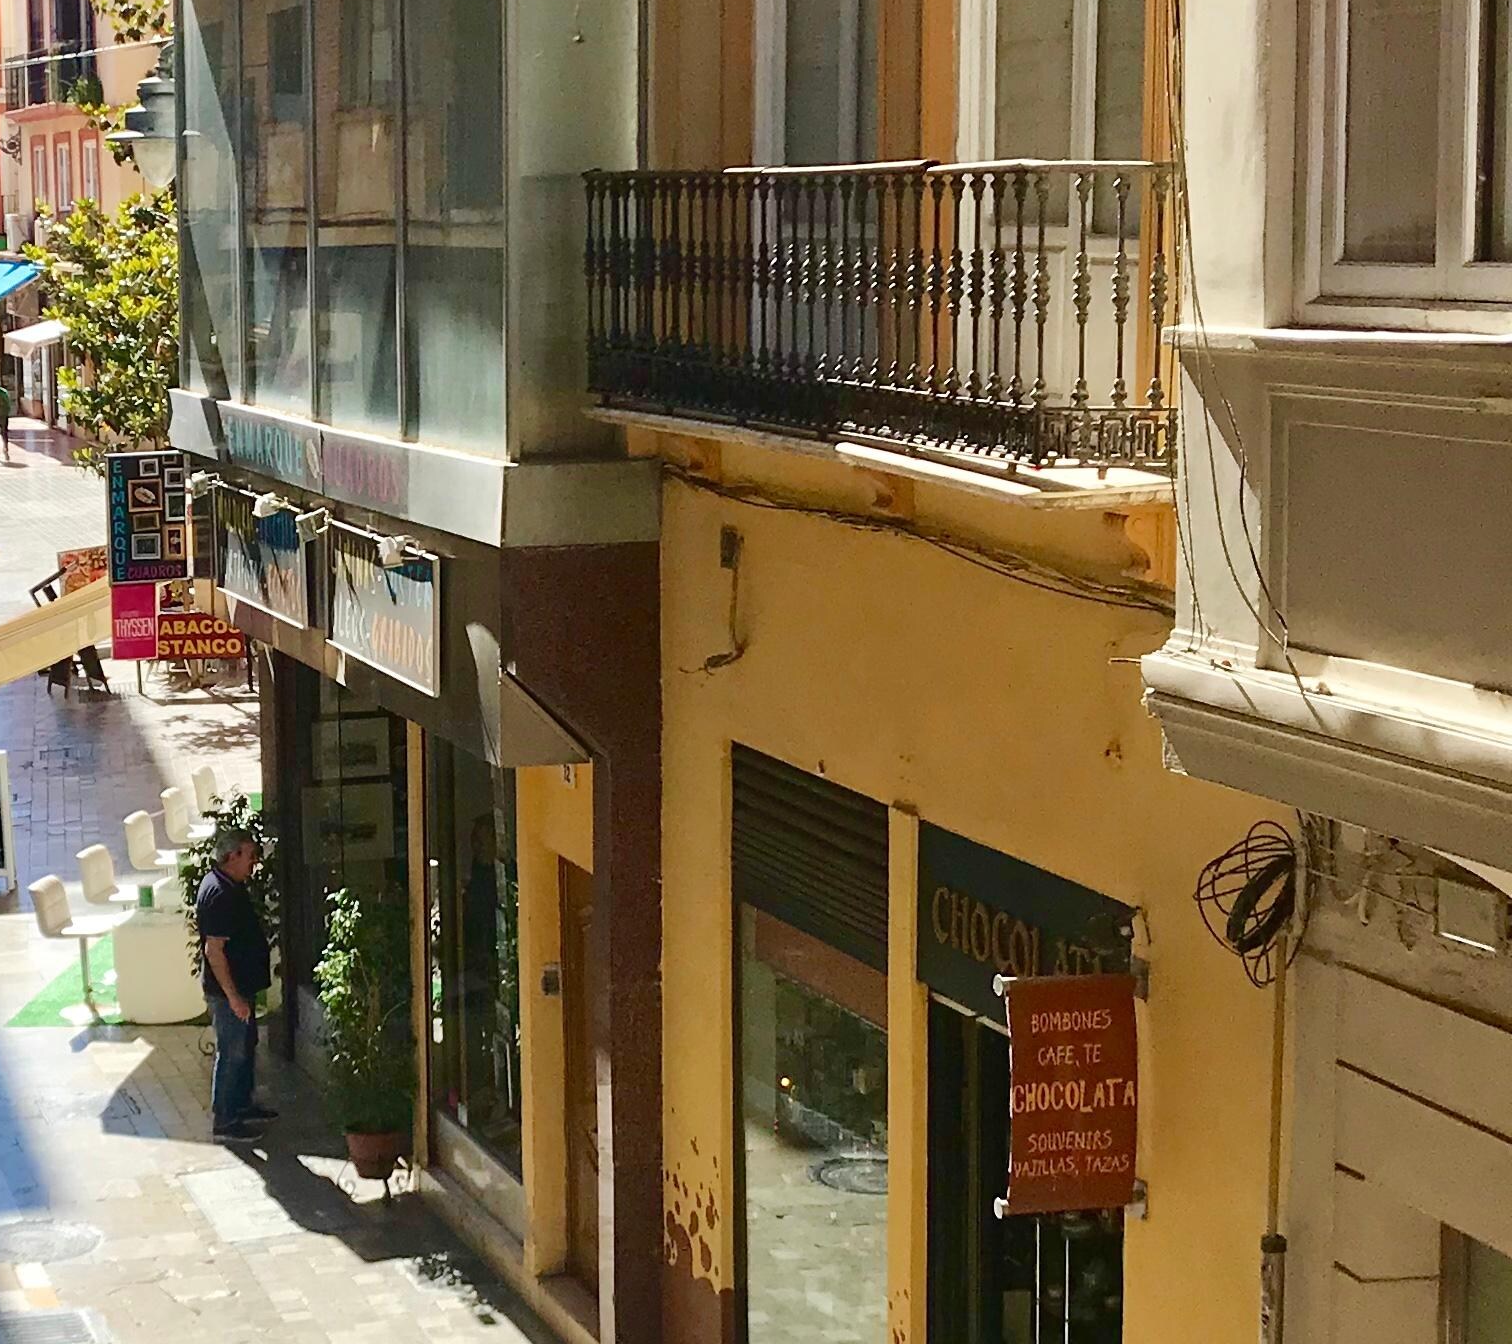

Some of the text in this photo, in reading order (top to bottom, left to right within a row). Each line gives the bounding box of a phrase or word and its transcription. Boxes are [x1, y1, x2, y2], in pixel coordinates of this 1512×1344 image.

[225, 416, 303, 476] ENMARQUE
[112, 460, 127, 581] ENMARQUE
[127, 564, 182, 579] CUADROS
[114, 617, 155, 638] THYSSEN
[1031, 1009, 1113, 1033] BOMBONES
[1038, 1043, 1102, 1067] CAFE, TE
[1013, 1078, 1136, 1113] CHOCOLATA
[1027, 1129, 1113, 1153] SOUVENIRS
[1013, 1154, 1130, 1178] VAJILLAS, TAZAS
